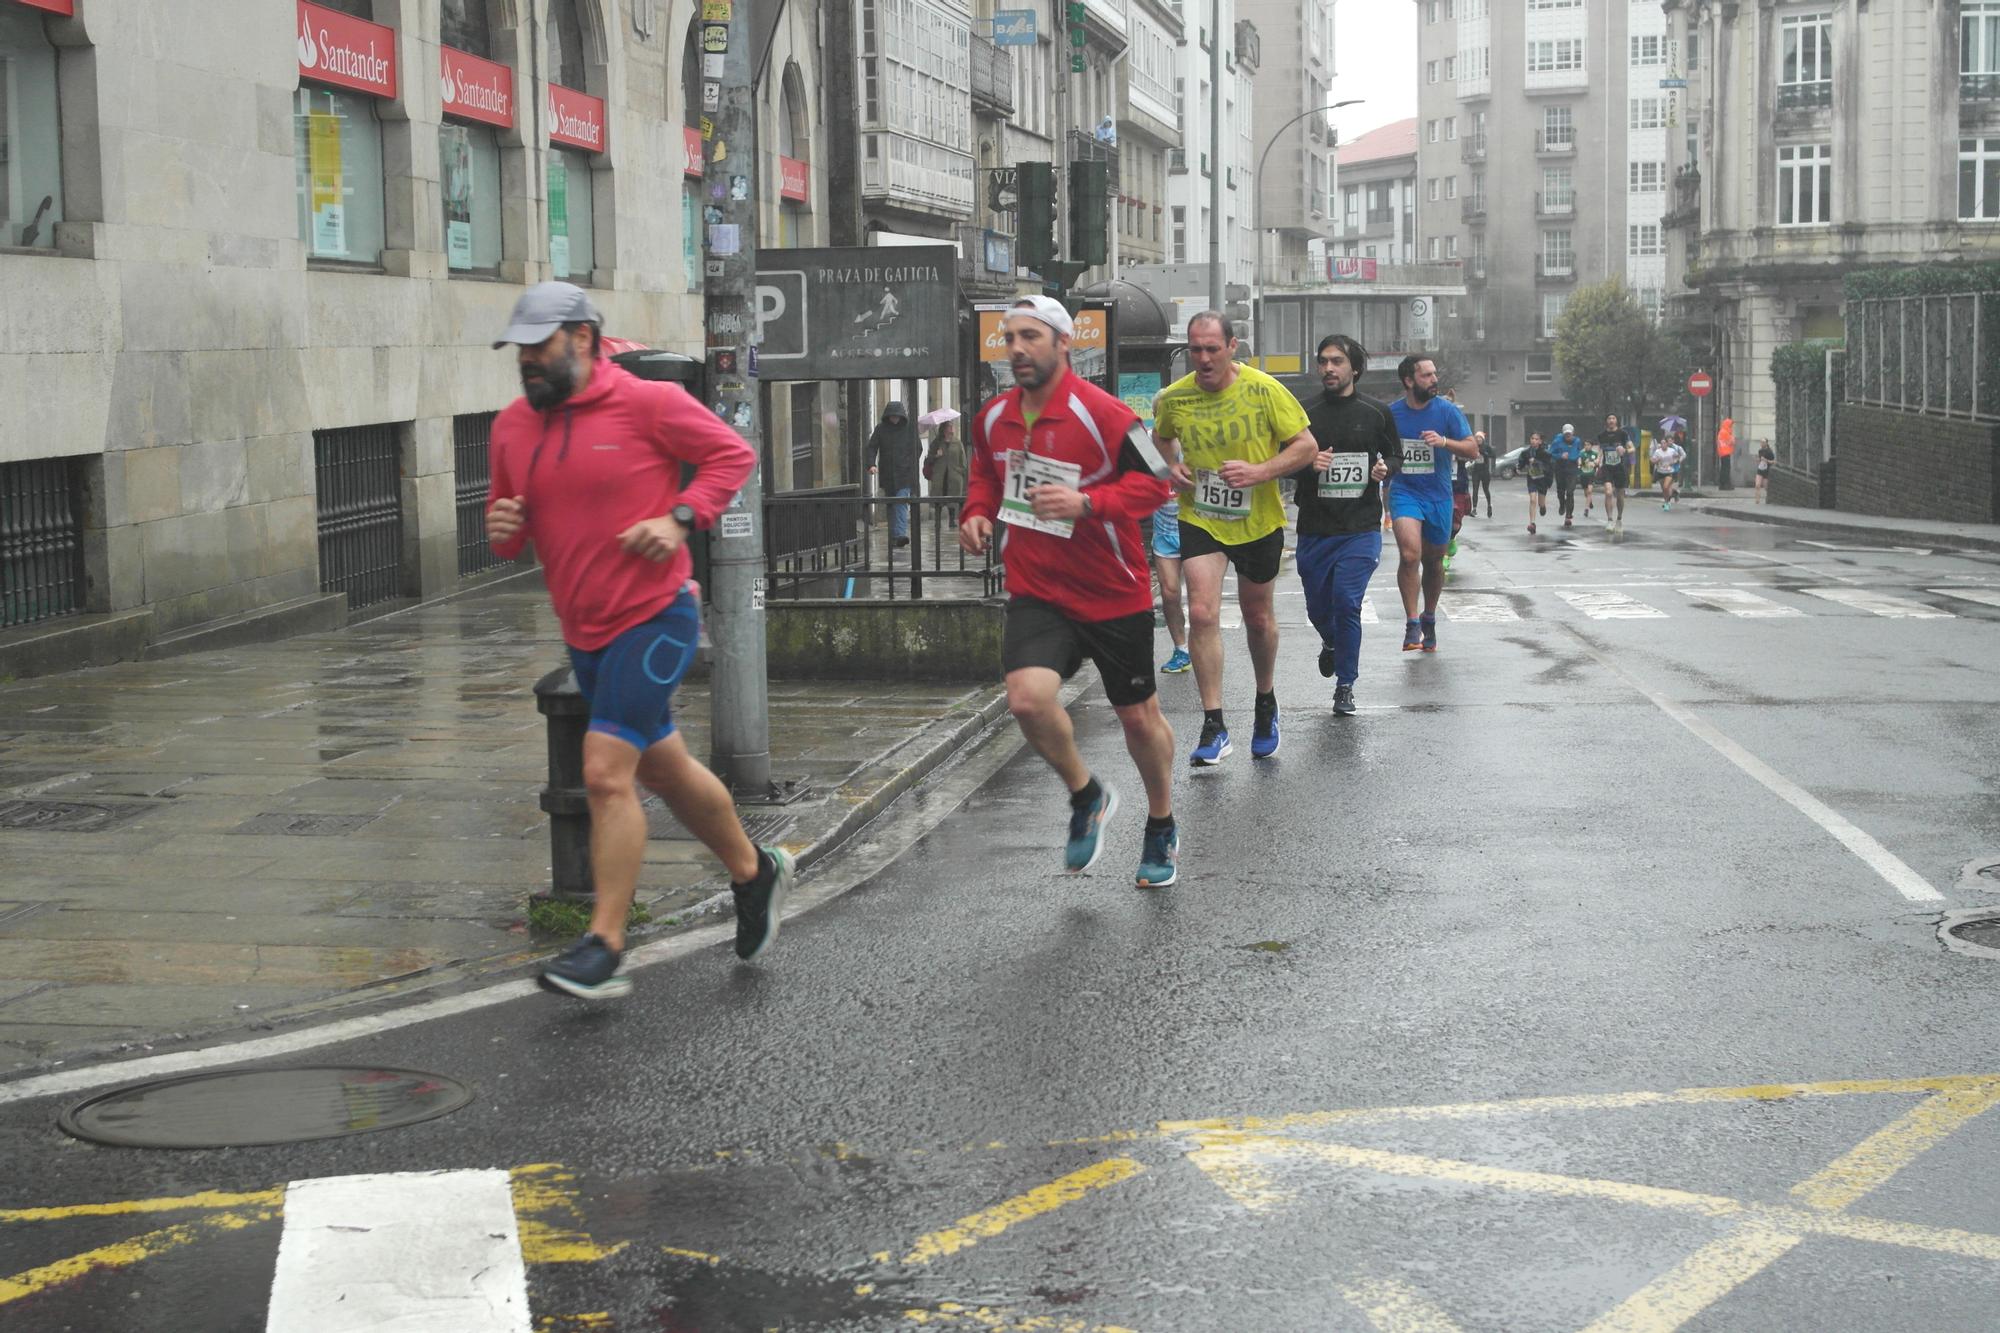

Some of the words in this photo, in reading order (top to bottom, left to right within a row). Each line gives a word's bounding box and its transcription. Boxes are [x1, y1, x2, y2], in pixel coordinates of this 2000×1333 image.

[319, 29, 389, 85] Santander
[456, 68, 508, 116] Santander
[559, 103, 600, 145] Santander
[819, 268, 861, 284] PRAZA
[865, 267, 882, 282] DE
[755, 285, 786, 343] P
[1012, 472, 1052, 501] 15
[1202, 485, 1243, 508] 1519
